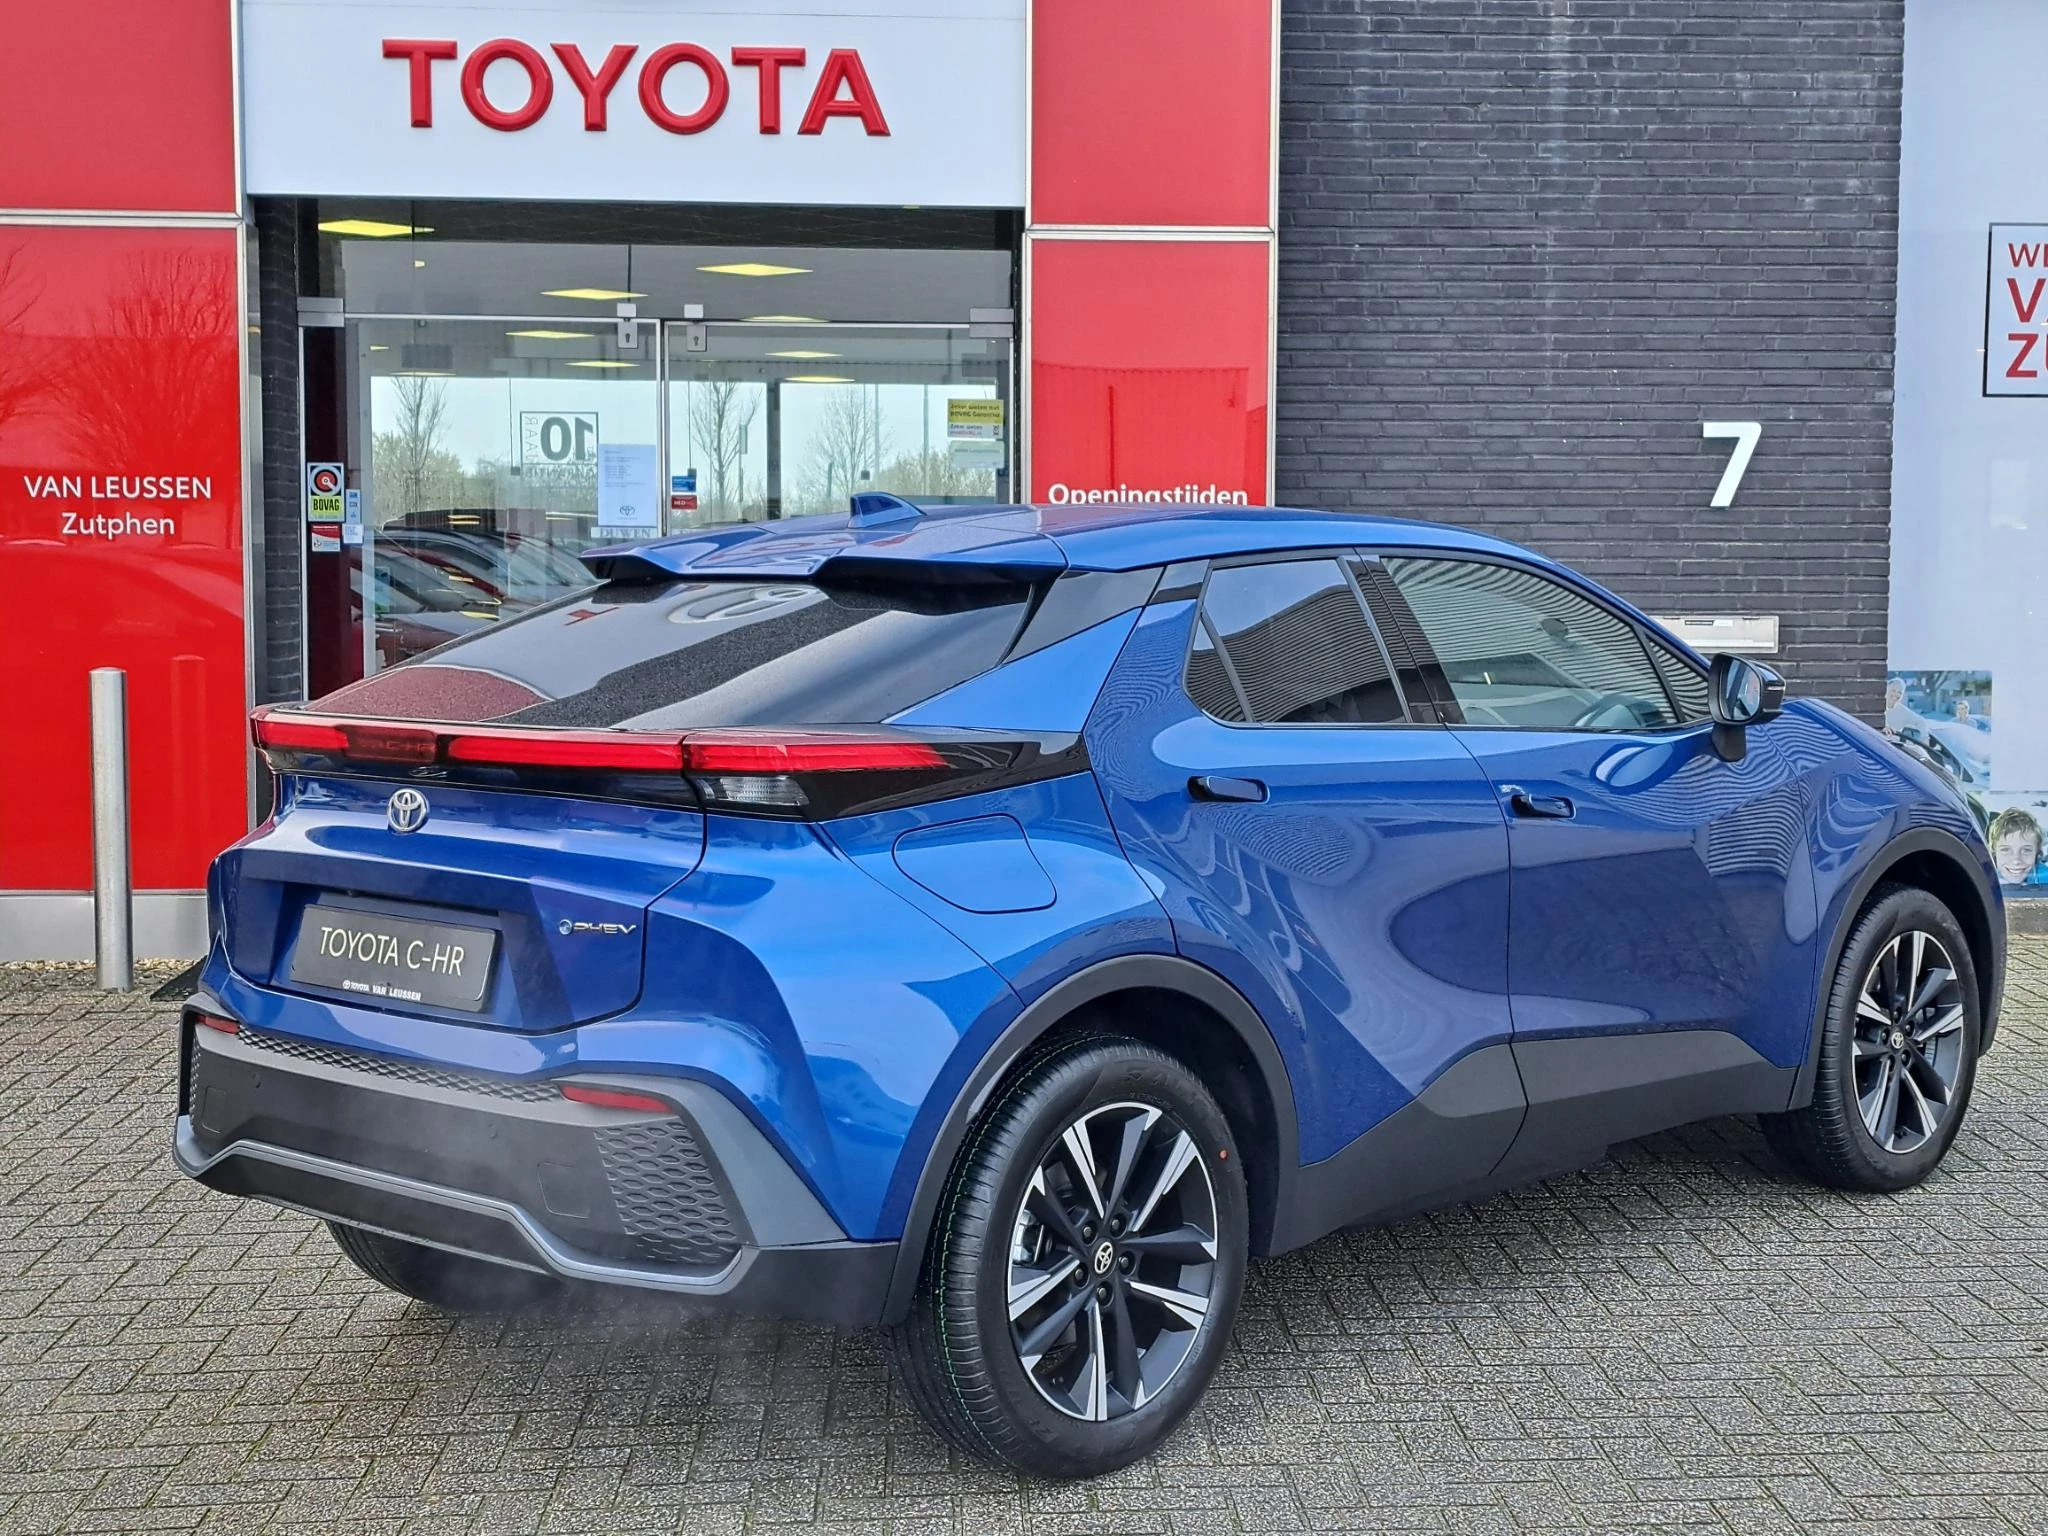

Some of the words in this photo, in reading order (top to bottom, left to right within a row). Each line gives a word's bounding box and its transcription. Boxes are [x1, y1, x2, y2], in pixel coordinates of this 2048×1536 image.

[382, 38, 891, 136] TOYOTA
[1703, 422, 1762, 508] 7
[23, 476, 82, 498] VAN
[91, 476, 212, 499] LEUSSEN
[313, 499, 340, 511] BOVAG
[61, 512, 175, 540] Zutphen
[599, 526, 651, 539] DUWEN
[320, 926, 399, 967] TOYOTA
[406, 939, 465, 977] C-HR
[350, 982, 370, 992] TOYOTA
[372, 984, 387, 995] VAN
[389, 987, 422, 1001] LEUSSEN
